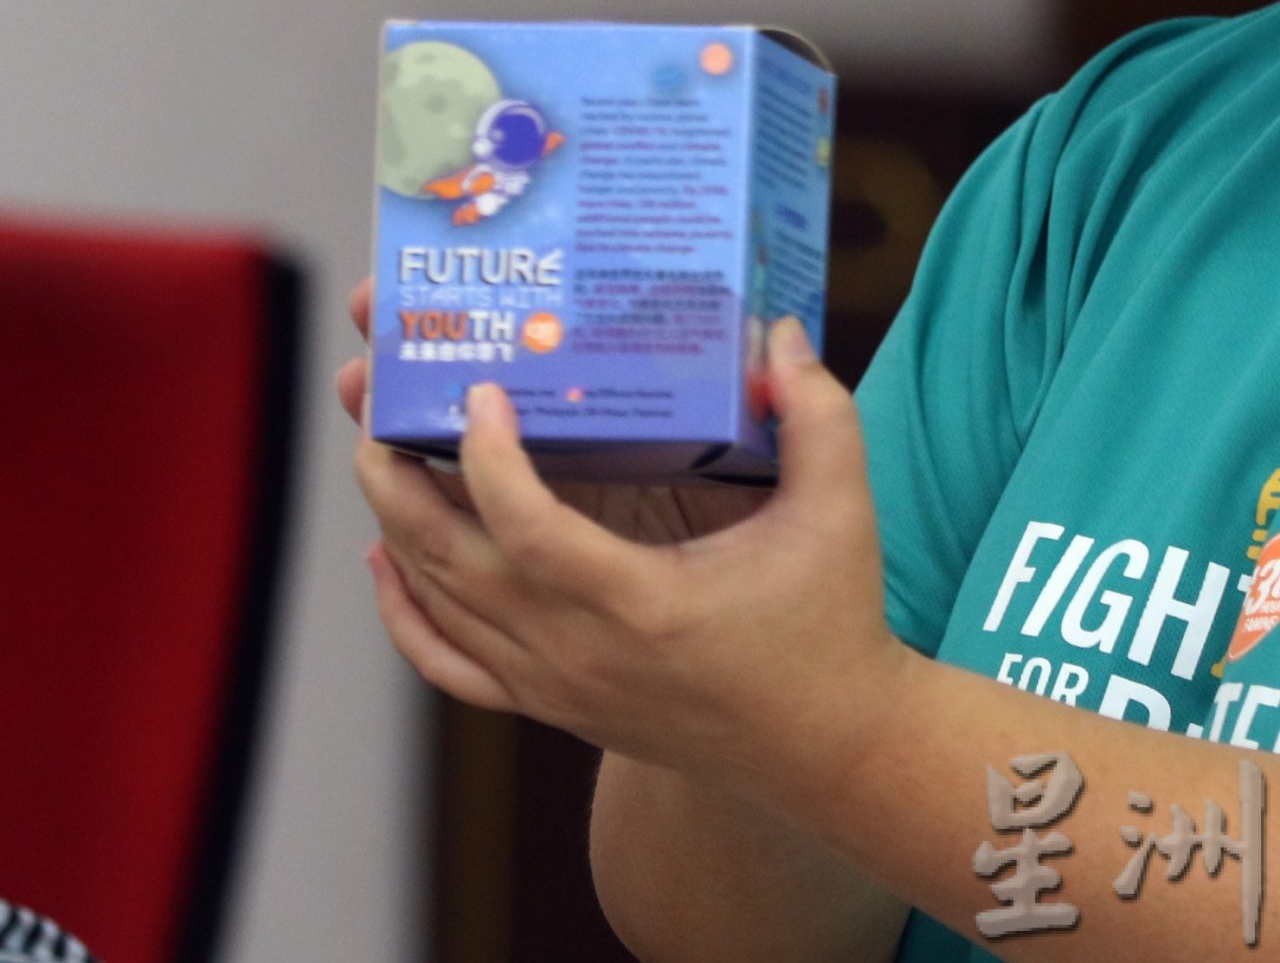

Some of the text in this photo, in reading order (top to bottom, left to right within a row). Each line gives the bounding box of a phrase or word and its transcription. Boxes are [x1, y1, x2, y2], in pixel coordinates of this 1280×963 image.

[399, 246, 566, 286] FUTURE
[402, 286, 492, 308] STARTS
[399, 309, 515, 342] YOUTH
[982, 520, 1252, 681] FIGH
